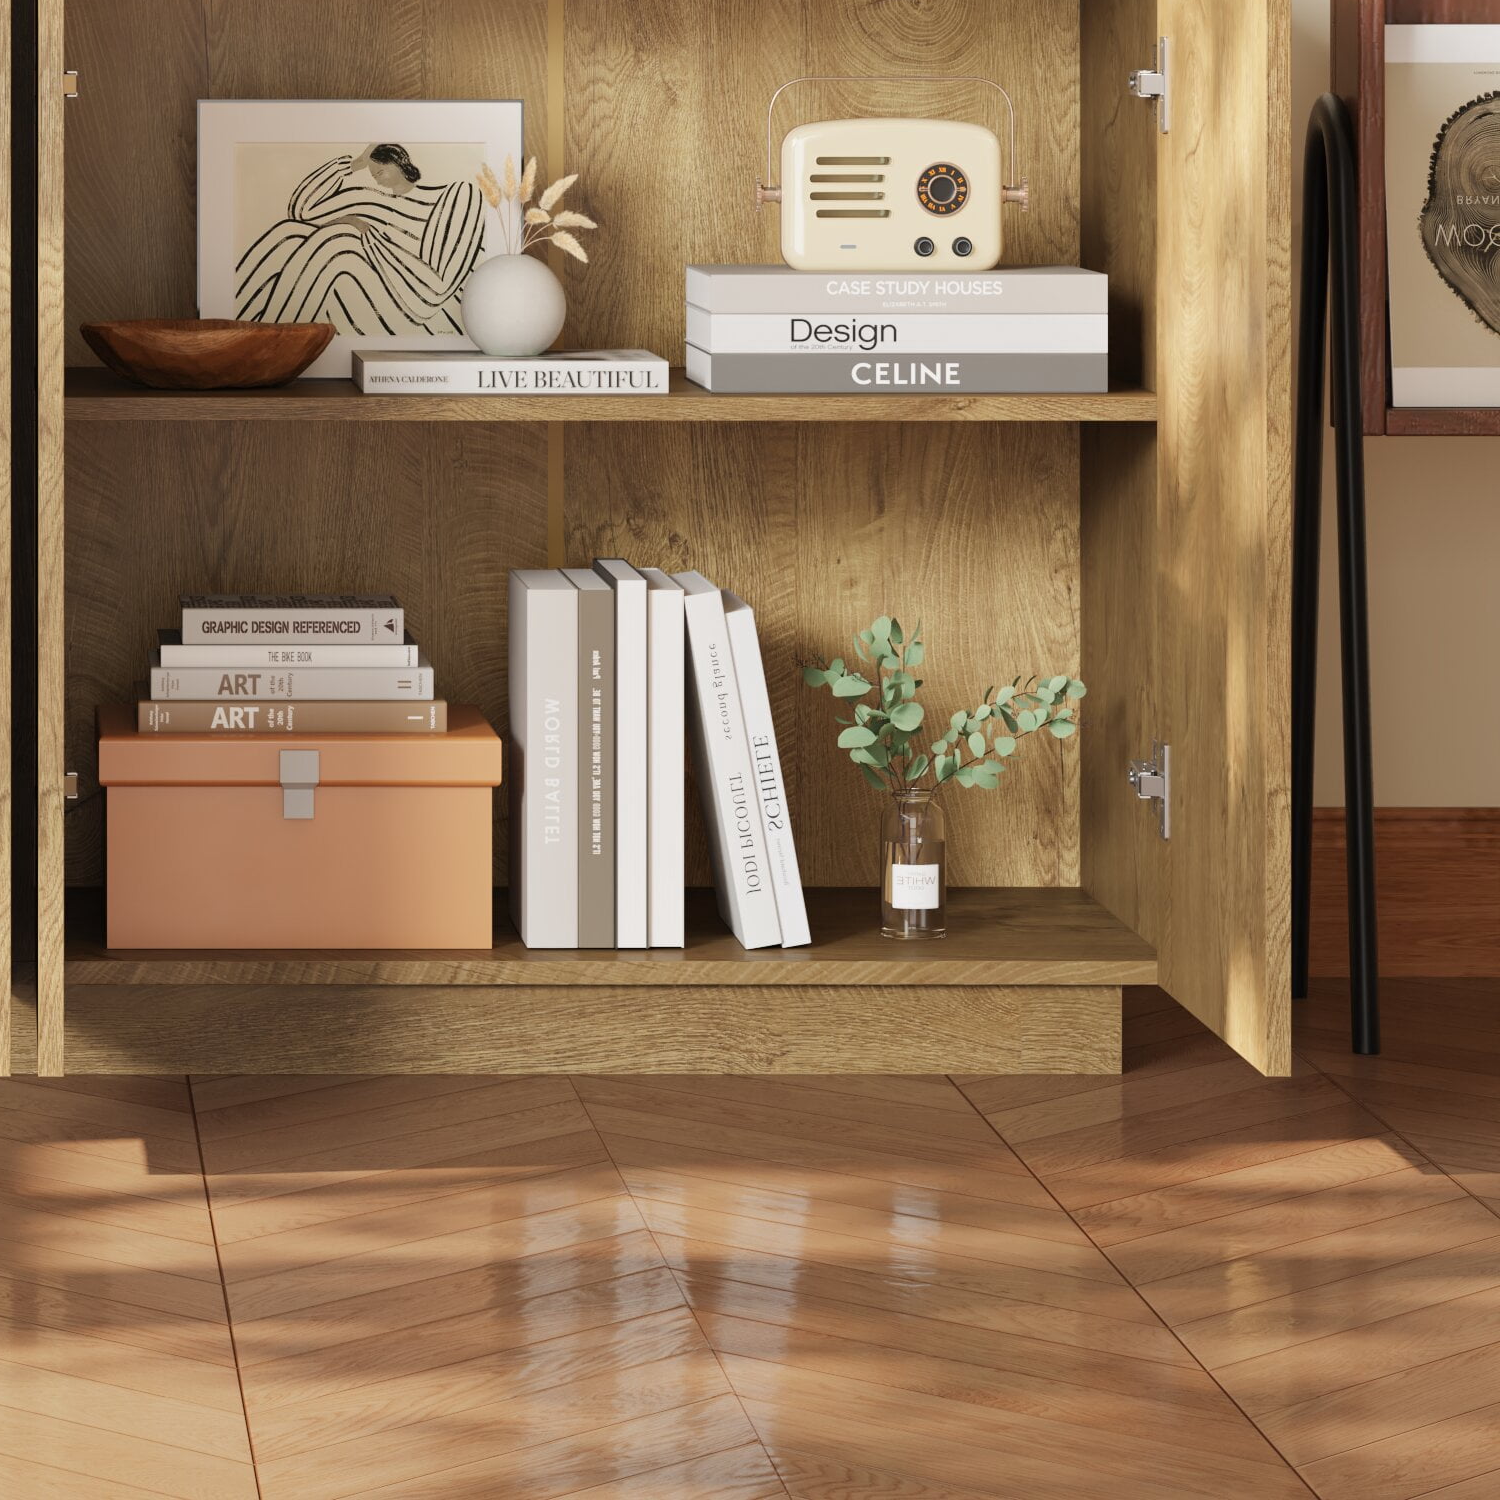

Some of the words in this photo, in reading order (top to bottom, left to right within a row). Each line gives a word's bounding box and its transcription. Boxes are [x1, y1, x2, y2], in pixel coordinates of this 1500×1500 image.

[826, 280, 871, 296] CASE
[875, 280, 931, 296] STUDY
[935, 280, 1003, 296] HOUSES
[790, 318, 897, 350] Design
[369, 375, 400, 384] ATHENA
[401, 375, 449, 384] CALDERONE
[477, 370, 527, 389] LIVE
[534, 370, 659, 389] BEAUTIFUL
[851, 362, 961, 386] CELINE
[202, 621, 248, 634] GRAPHIC
[251, 621, 289, 634] DESIGN
[292, 621, 361, 634] REFERENCED
[268, 651, 280, 662] THE
[281, 651, 295, 662] BIKE
[297, 651, 313, 662] BOOK
[217, 674, 261, 695] ART
[270, 686, 276, 694] of
[211, 707, 259, 729] ART
[268, 718, 275, 728] of
[286, 705, 294, 731] Century
